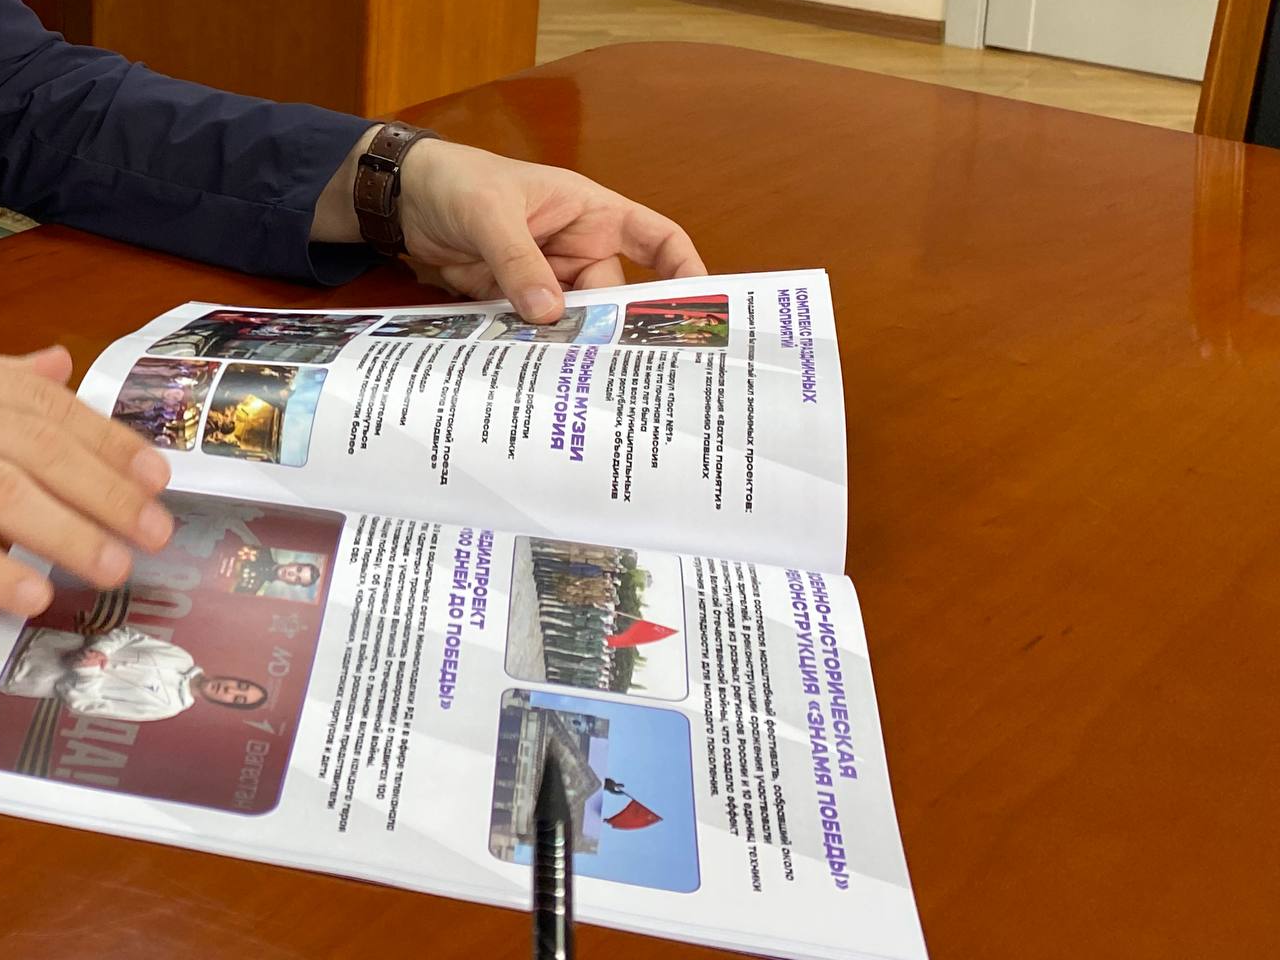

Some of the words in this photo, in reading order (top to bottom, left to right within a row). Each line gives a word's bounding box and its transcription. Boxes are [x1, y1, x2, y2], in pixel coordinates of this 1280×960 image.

[778, 289, 797, 348] МЕРОПРИЯТИЙ
[795, 288, 811, 336] КОМПЛЕКС
[561, 349, 578, 373] ЖИВАЯ
[576, 346, 599, 393] МОБИЛЬНЫЕ
[644, 372, 652, 389] много
[799, 339, 817, 403] ПРАЗДНИЧНЫХ
[354, 380, 369, 418] посетили
[400, 374, 417, 425] экспонатами
[439, 387, 448, 406] Сила
[606, 378, 616, 401] людей
[615, 378, 627, 427] республики,
[630, 387, 638, 405] всех
[654, 385, 662, 423] почетная
[667, 393, 675, 417] «Пост
[704, 376, 713, 430] захоронению
[717, 388, 725, 412] акция
[747, 379, 755, 395] цикл
[361, 384, 379, 449] прикоснуться
[375, 394, 388, 436] жителям
[482, 402, 492, 444] колесах
[508, 406, 519, 460] выставки:
[522, 394, 533, 438] работали
[551, 377, 573, 450] ИСТОРИЯ
[570, 397, 588, 461] МУЗЕИ
[641, 407, 650, 432] была
[716, 415, 724, 451] «Вахта
[348, 421, 359, 454] более
[431, 416, 442, 469] подвиге»
[624, 407, 636, 502] муниципальных
[651, 426, 659, 468] миссия
[702, 433, 710, 478] павших
[440, 446, 451, 485] поезд
[611, 431, 622, 499] объединив
[715, 455, 723, 510] памяти»
[745, 448, 753, 513] проектов:
[414, 533, 426, 575] «Дагестан»
[452, 549, 471, 590] ДНЕЙ
[372, 574, 380, 585] Об
[380, 565, 394, 615] ежедневно
[393, 565, 408, 616] участников
[422, 552, 435, 603] социальных
[470, 530, 494, 630] МЕДИАПРОЕКТ
[710, 576, 722, 607] Великой
[362, 588, 378, 641] участниках
[400, 577, 418, 658] транслировались
[418, 605, 428, 631] сетях
[449, 593, 465, 619] ДО
[737, 583, 748, 621] зрителей.
[755, 600, 766, 647] состоялся
[370, 617, 386, 673] напоминать
[386, 619, 399, 658] Великой
[699, 598, 711, 659] наглядности
[714, 610, 728, 684] Отечественной
[729, 631, 737, 642] из
[785, 569, 820, 695] РЕКОНСТРУКЦИЯ
[336, 647, 352, 697] кадетских
[356, 644, 367, 673] войны
[407, 634, 424, 704] Минмолодежи
[439, 624, 462, 710] ПОБЕДЫ»
[702, 661, 710, 680] для
[728, 644, 740, 682] разных
[742, 633, 757, 712] реконструкции
[344, 676, 361, 732] рассказали
[362, 683, 375, 718] личном
[374, 660, 394, 733] Отечественной
[389, 661, 406, 725] видеоролики
[719, 687, 731, 722] войны,
[760, 650, 776, 716] масштабный
[326, 700, 341, 744] корпусов
[404, 707, 414, 720] РД
[704, 683, 715, 734] молодого
[732, 685, 744, 735] регионов
[354, 721, 367, 756] вкладе
[367, 735, 380, 768] войны.
[379, 735, 394, 781] подвигах
[396, 739, 409, 768] эфире
[721, 726, 730, 744] что
[737, 738, 748, 777] России
[749, 716, 765, 772] сражения
[764, 720, 780, 781] фестиваль,
[807, 701, 833, 786] «ЗНАМЯ
[319, 755, 330, 778] дети
[328, 735, 350, 809] представители
[344, 758, 359, 801] каждого
[707, 737, 719, 797] поколения.
[723, 747, 734, 793] создало
[376, 784, 387, 800] 100
[387, 771, 403, 831] телеканала
[742, 790, 751, 799] 10
[754, 775, 772, 844] участвовали
[773, 785, 792, 845] собравший
[338, 803, 351, 832] героя
[726, 796, 739, 836] эффект
[743, 803, 755, 842] единиц
[817, 791, 849, 890] ПОБЕДЫ»
[749, 846, 761, 892] техники
[782, 848, 794, 880] около
